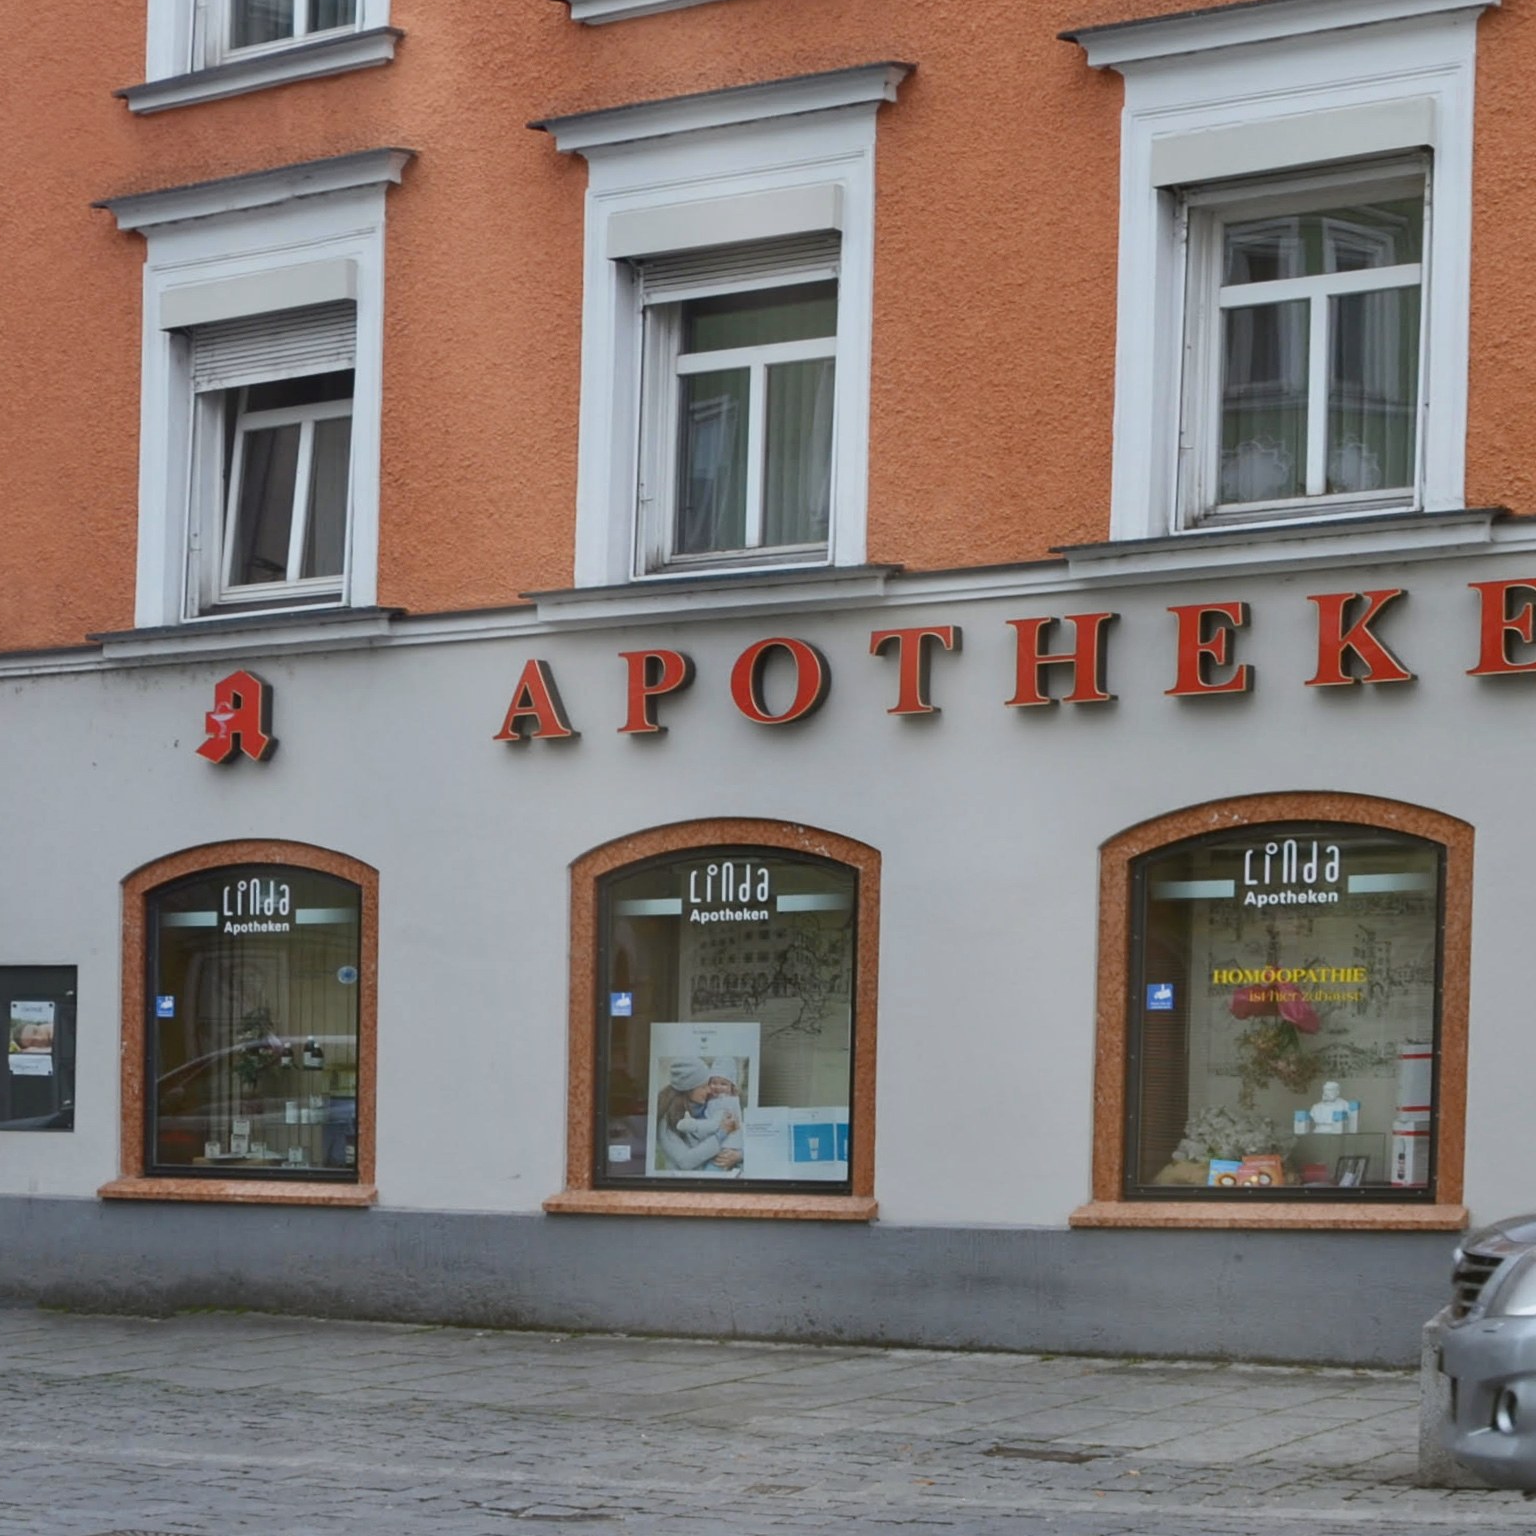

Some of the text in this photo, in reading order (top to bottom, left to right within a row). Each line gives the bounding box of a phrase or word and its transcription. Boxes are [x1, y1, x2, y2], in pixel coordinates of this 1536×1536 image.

[1244, 889, 1339, 908] Apotheken
[690, 907, 769, 925] Apotheken
[224, 920, 290, 936] Apotheken
[1213, 966, 1368, 985] HOMÖOPATHIE
